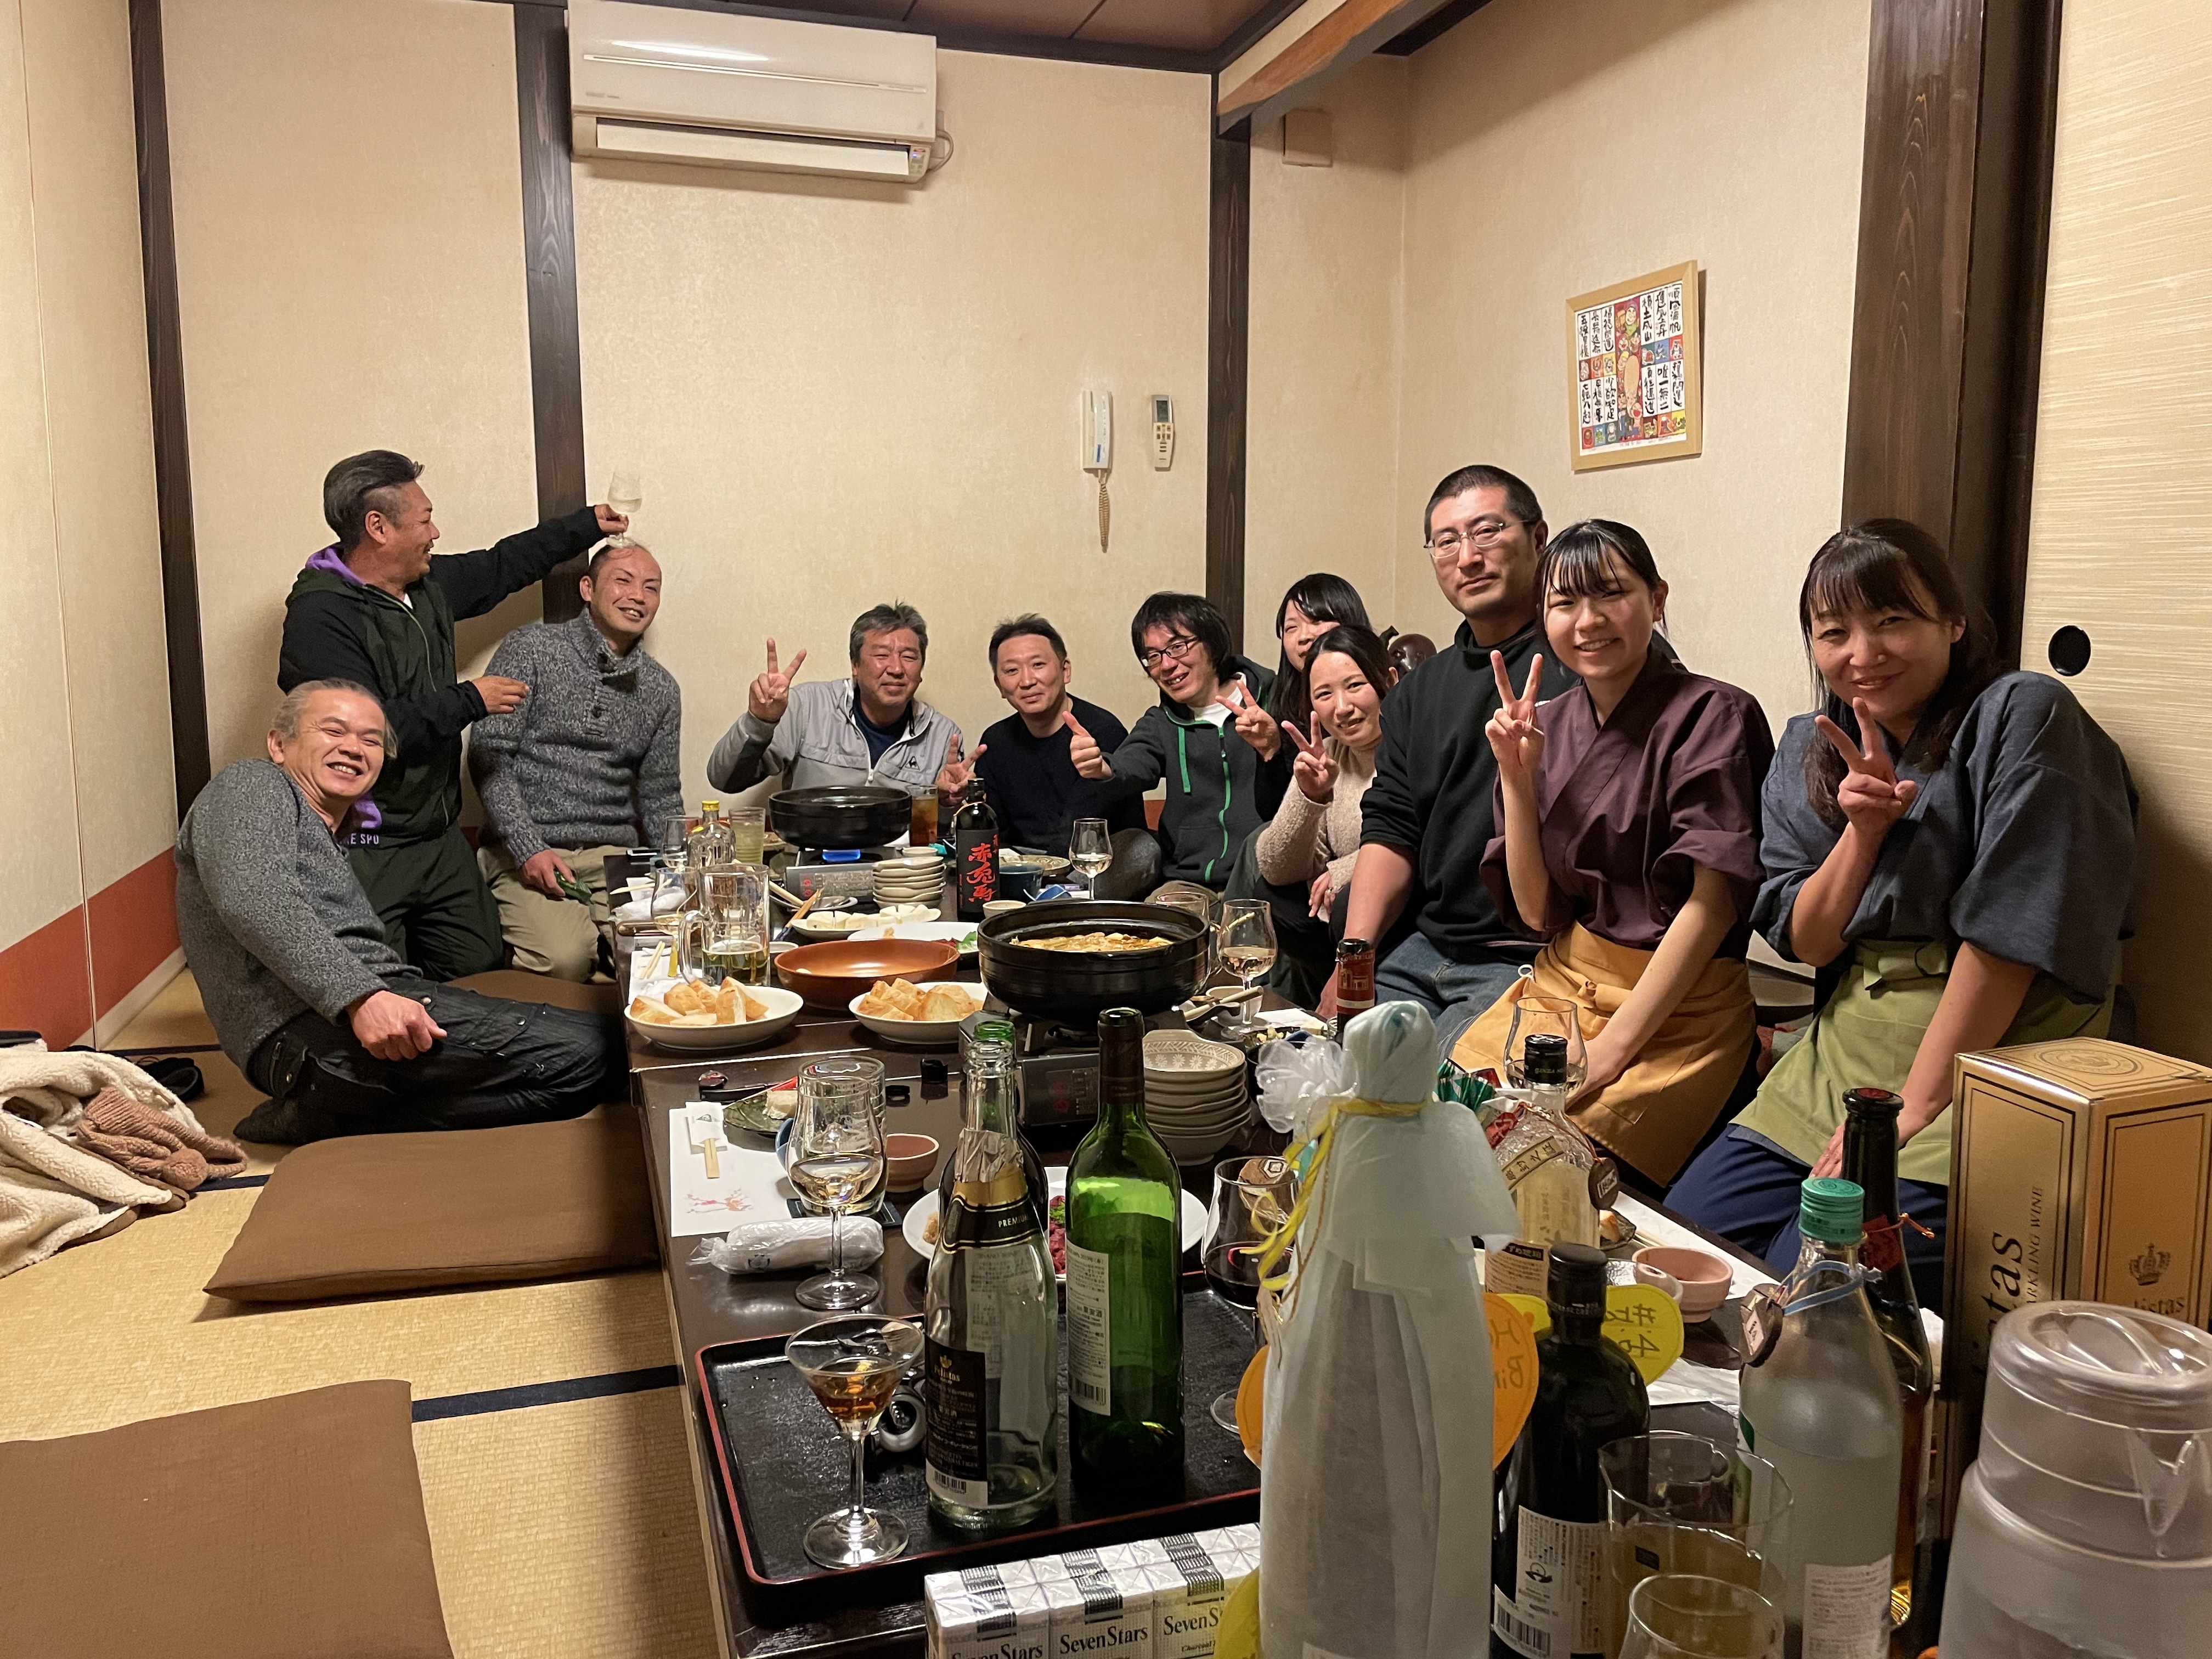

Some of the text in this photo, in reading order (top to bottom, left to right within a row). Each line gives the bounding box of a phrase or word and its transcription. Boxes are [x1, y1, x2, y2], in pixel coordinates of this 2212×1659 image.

[1657, 364, 1668, 410] 唯一無二
[2030, 1186, 2043, 1227] WINE
[1980, 1231, 2023, 1317] tas
[1164, 1607, 1223, 1635] SevenS
[952, 1644, 1043, 1659] nStars
